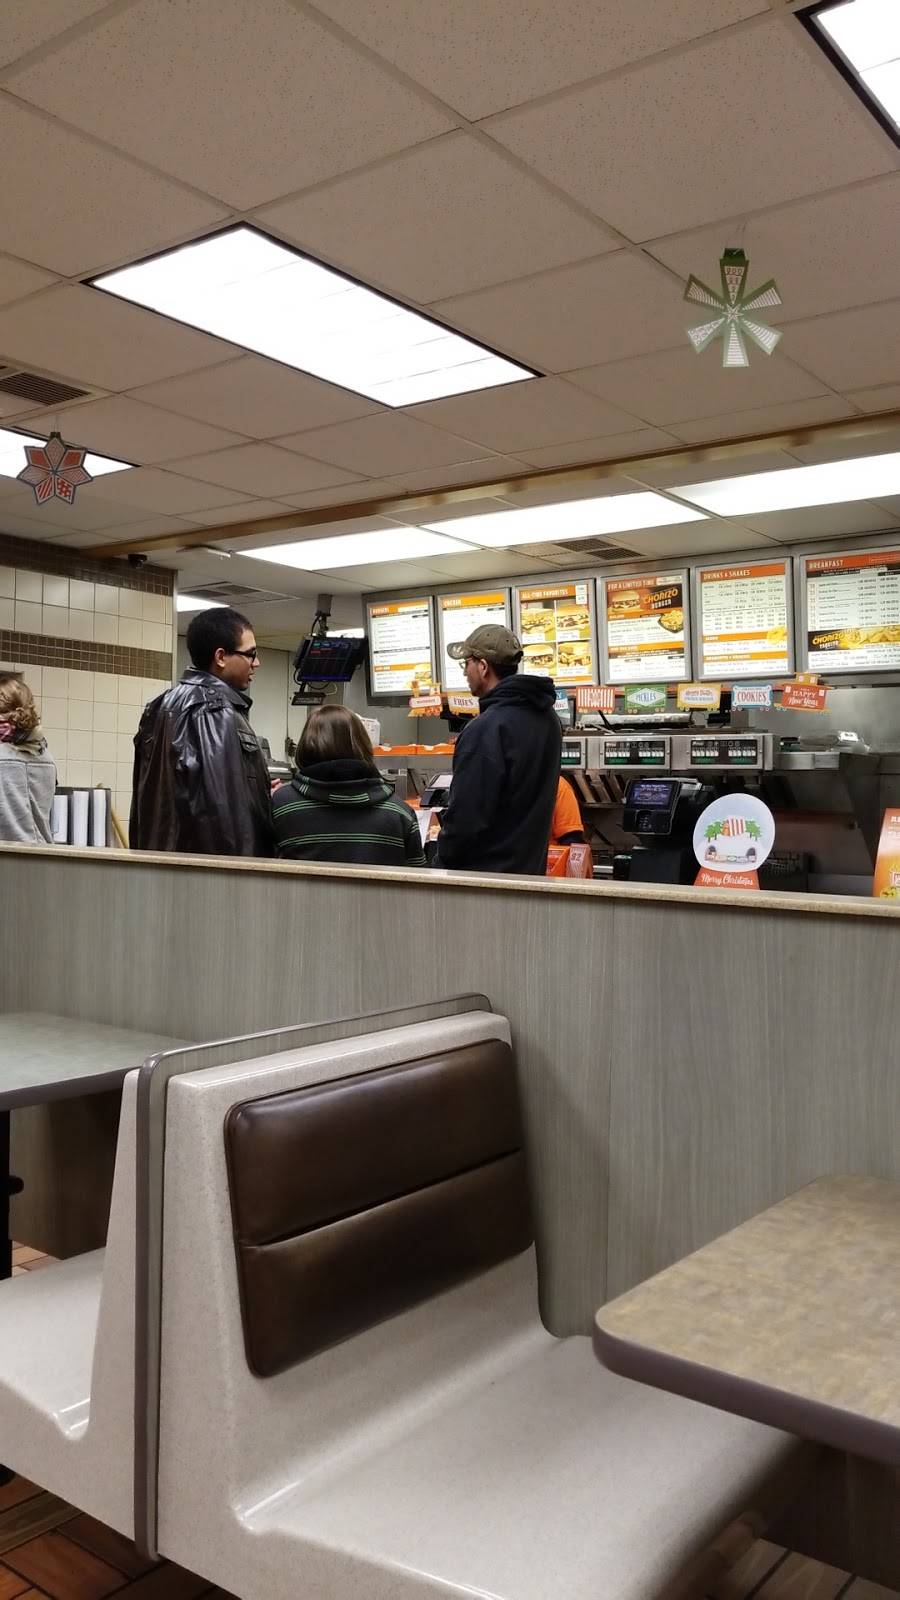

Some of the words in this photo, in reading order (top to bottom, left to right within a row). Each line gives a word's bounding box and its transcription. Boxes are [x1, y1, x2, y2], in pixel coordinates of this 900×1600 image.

[808, 560, 844, 569] BREAKFAST
[703, 571, 724, 580] DRINKS
[729, 569, 751, 577] SHAKES
[607, 582, 618, 590] FOR
[623, 580, 642, 588] LIMITED
[643, 588, 678, 604] CHORIZO
[812, 631, 845, 645] CHORIZO
[635, 694, 656, 702] PICKLES
[737, 691, 767, 702] COOKIES
[792, 690, 816, 698] HAPPY
[453, 698, 474, 706] FRIES
[788, 696, 802, 705] New
[701, 872, 722, 886] Merry
[722, 872, 753, 886] Christmas
